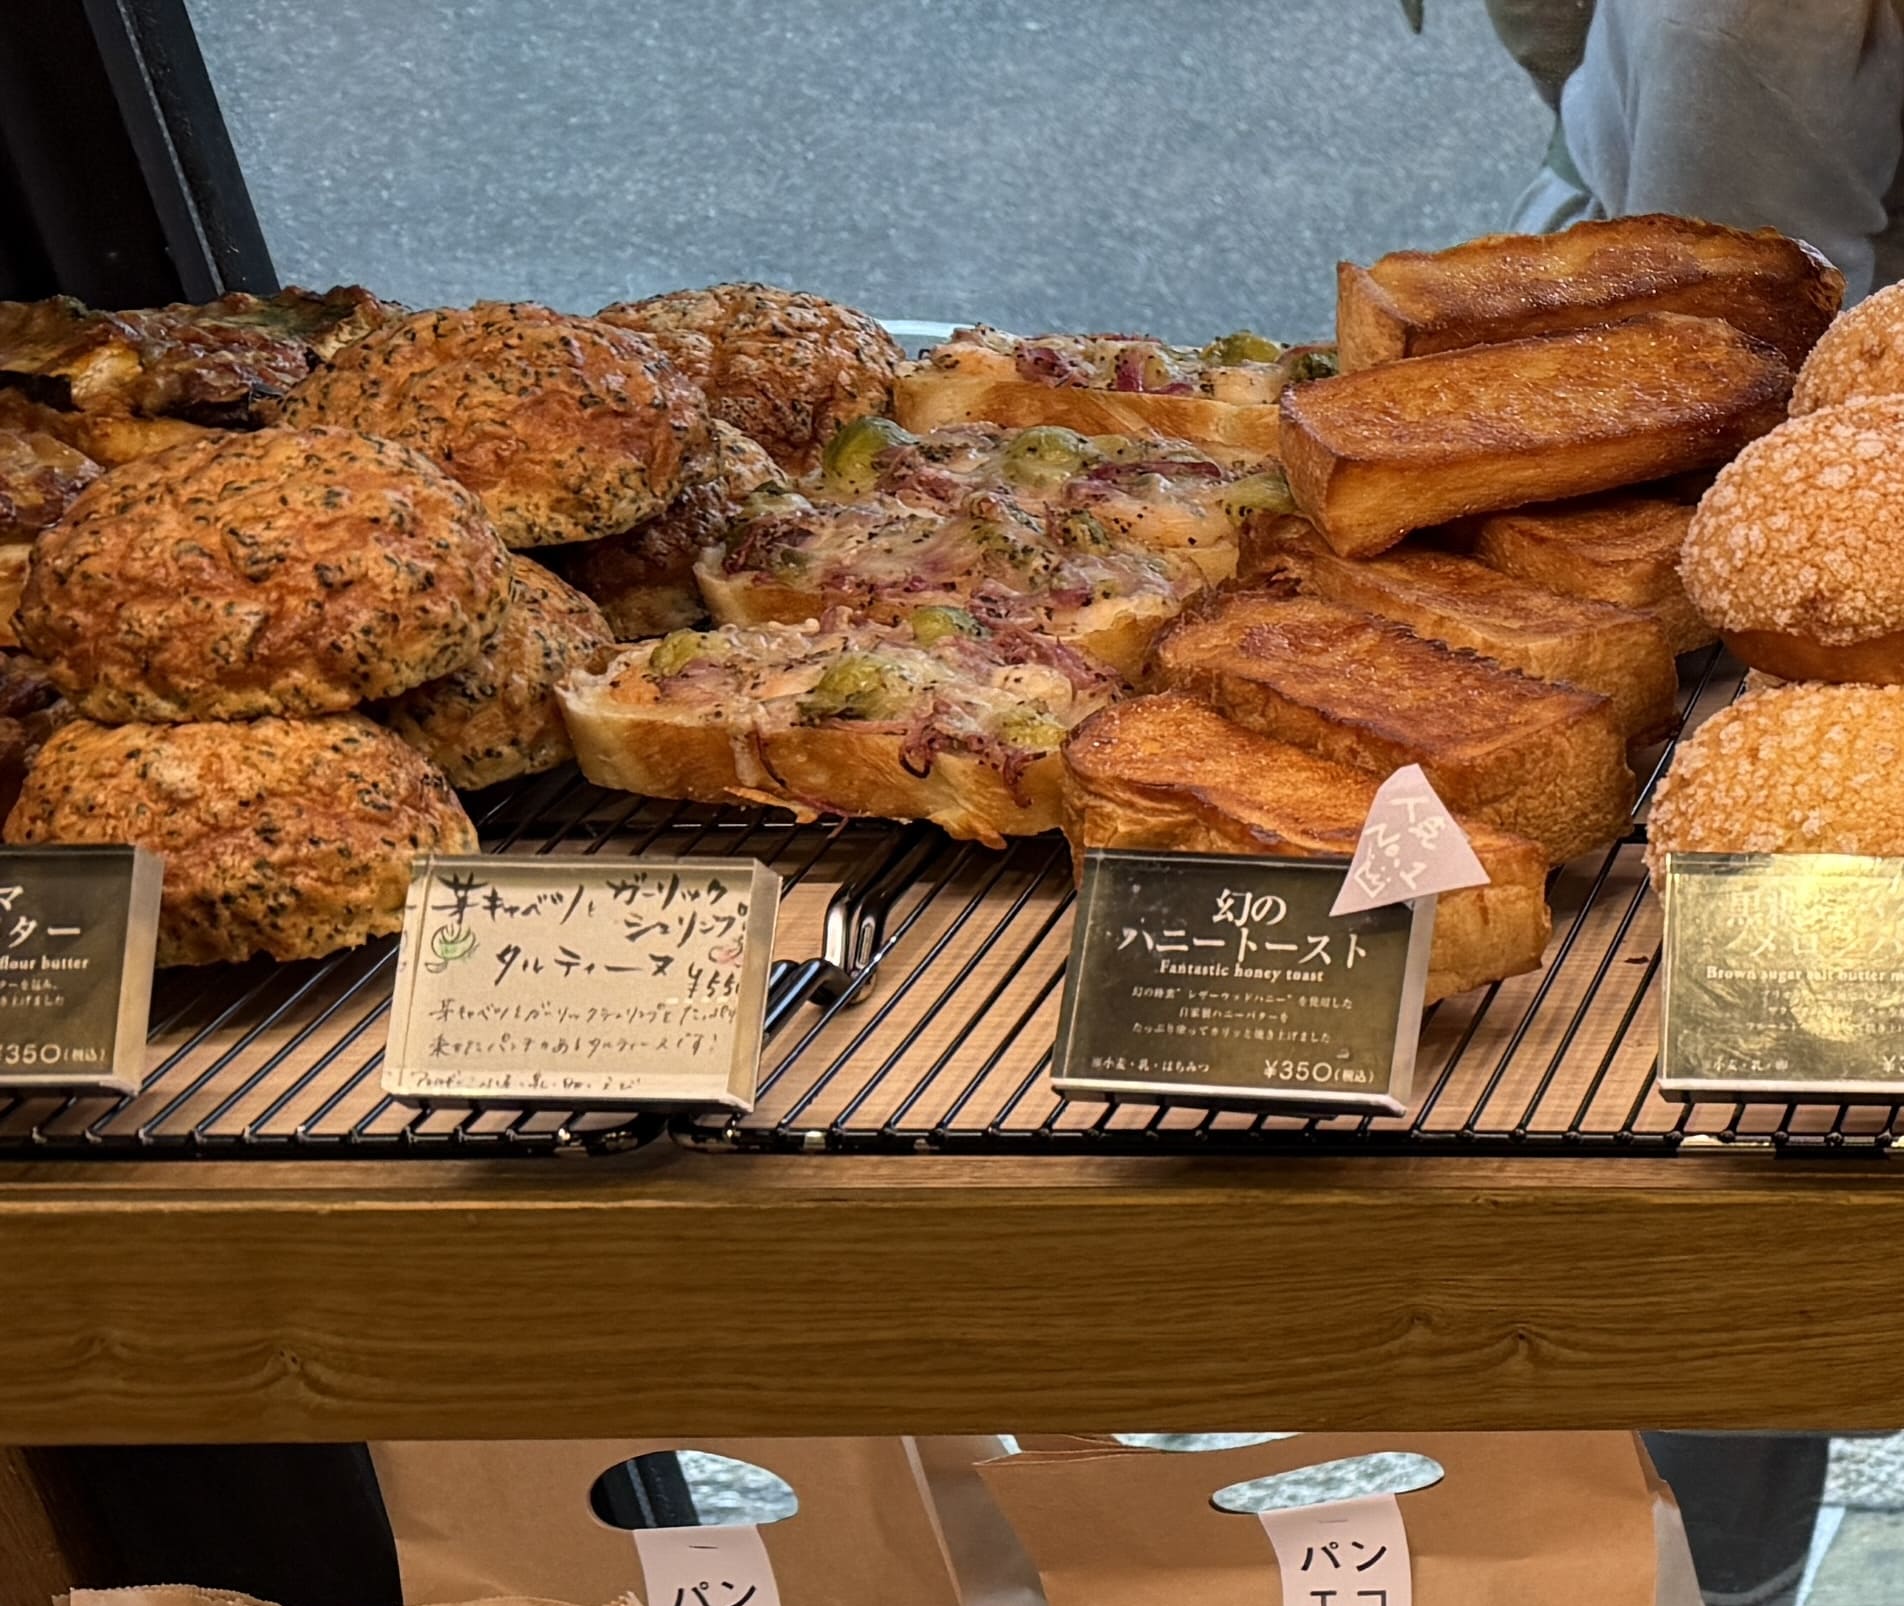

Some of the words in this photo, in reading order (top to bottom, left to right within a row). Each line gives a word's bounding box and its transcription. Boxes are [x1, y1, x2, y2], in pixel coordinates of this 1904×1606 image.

[1211, 887, 1288, 928] 幻の
[1115, 925, 1368, 970] ハニートースト
[41, 955, 89, 971] butter
[1159, 957, 1231, 979] Fantastic
[1234, 963, 1283, 983] honey
[1286, 968, 1326, 983] toast
[1705, 965, 1757, 982] Brown
[0, 1042, 107, 1065] 350(税込)
[1300, 1541, 1387, 1573] パン
